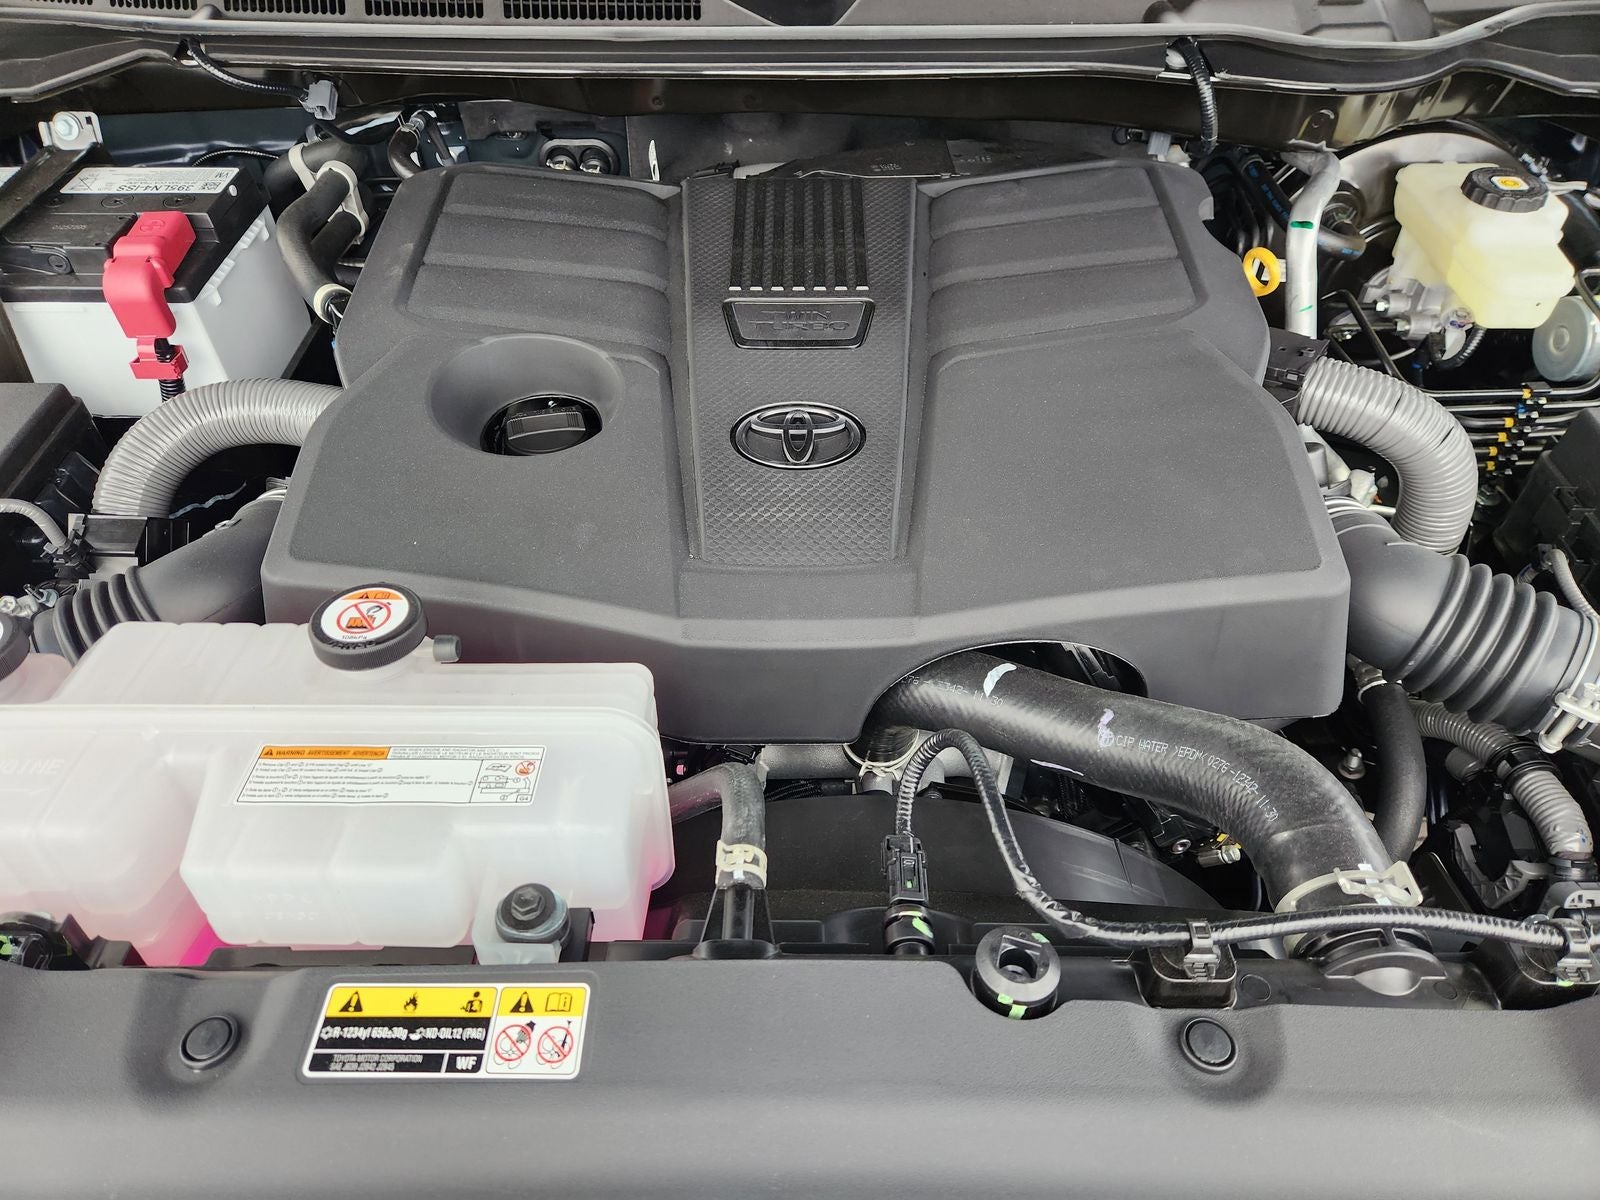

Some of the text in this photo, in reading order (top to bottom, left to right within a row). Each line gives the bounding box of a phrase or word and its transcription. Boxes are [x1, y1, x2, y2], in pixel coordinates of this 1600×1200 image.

[116, 184, 193, 192] 395LN4-ISS
[1138, 739, 1169, 753] WATER
[455, 1056, 477, 1071] WF
